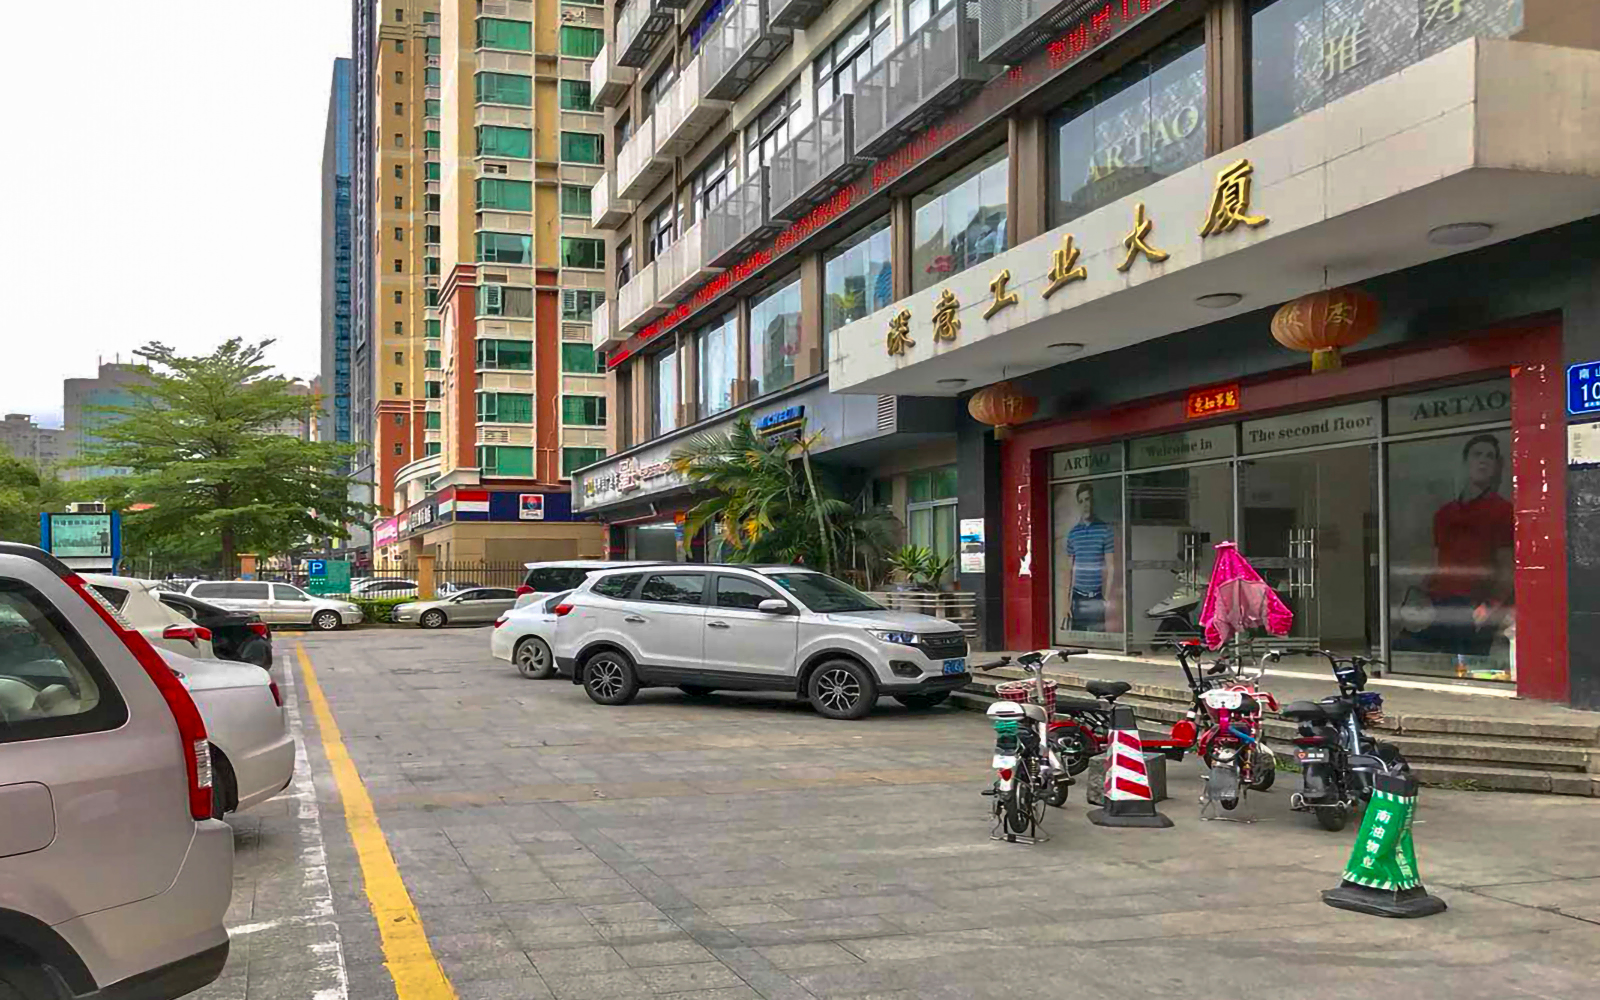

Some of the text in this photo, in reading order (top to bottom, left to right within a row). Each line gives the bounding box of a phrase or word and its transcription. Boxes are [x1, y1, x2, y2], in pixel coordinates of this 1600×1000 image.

[1084, 105, 1199, 184] ARTAO
[886, 157, 1270, 356] 深意工业大厦
[1411, 389, 1508, 422] ARTAO
[1249, 414, 1374, 443] The second floor
[1199, 437, 1213, 451] in
[1063, 453, 1111, 472] ARTAO
[312, 562, 323, 573] P
